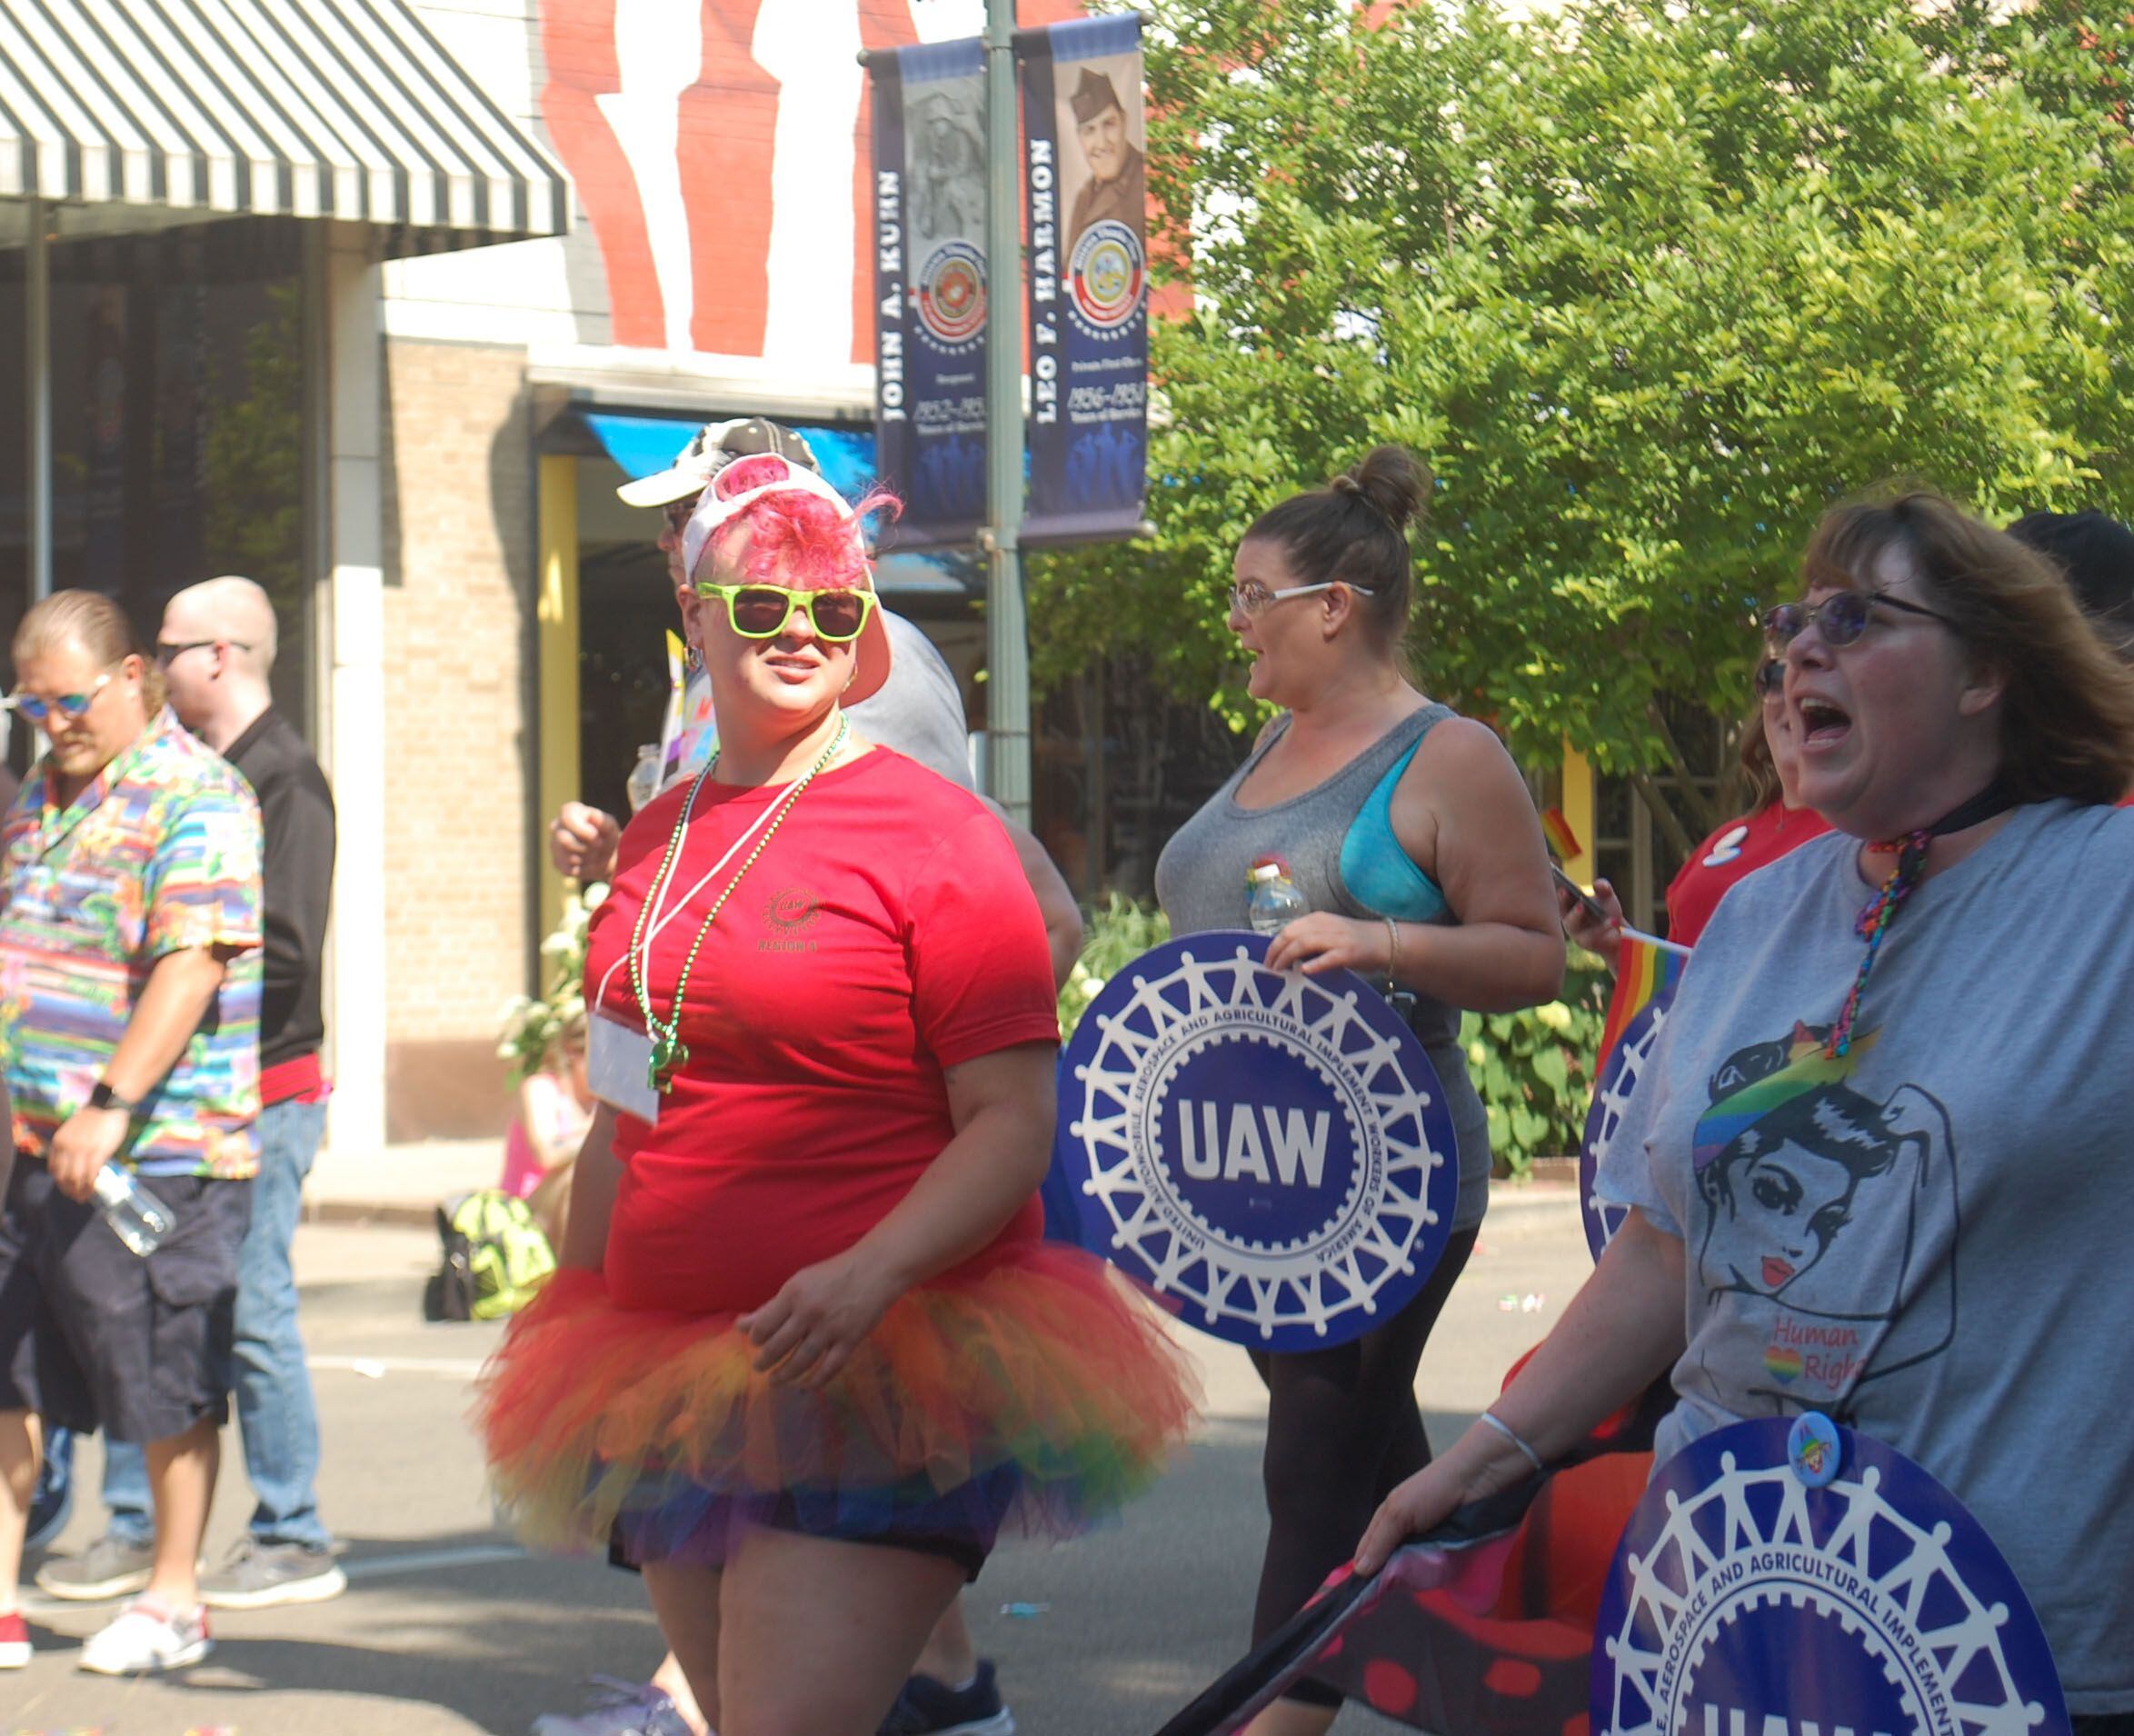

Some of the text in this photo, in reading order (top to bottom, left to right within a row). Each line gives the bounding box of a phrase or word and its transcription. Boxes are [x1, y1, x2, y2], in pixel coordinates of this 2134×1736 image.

[1031, 139, 1055, 302] HARMON
[878, 171, 906, 422] JOHN A. KUHN
[1037, 355, 1057, 424] LEO
[1181, 1015, 1209, 1037] AND
[1213, 1009, 1312, 1046] AGRICULTURAL
[1316, 1041, 1373, 1116] IMPLEMENT
[1178, 1099, 1331, 1188] UAW
[1367, 1122, 1382, 1193] WORKERS
[1162, 1207, 1206, 1252] UNITED
[1363, 1196, 1375, 1217] OF
[1315, 1217, 1362, 1262] AMERICA
[1774, 1315, 1860, 1348] Human
[1804, 1352, 1866, 1392] Righ
[1660, 1551, 1956, 1736] AEROSPACE AND AGRICULTURAL IMPLEMENT
